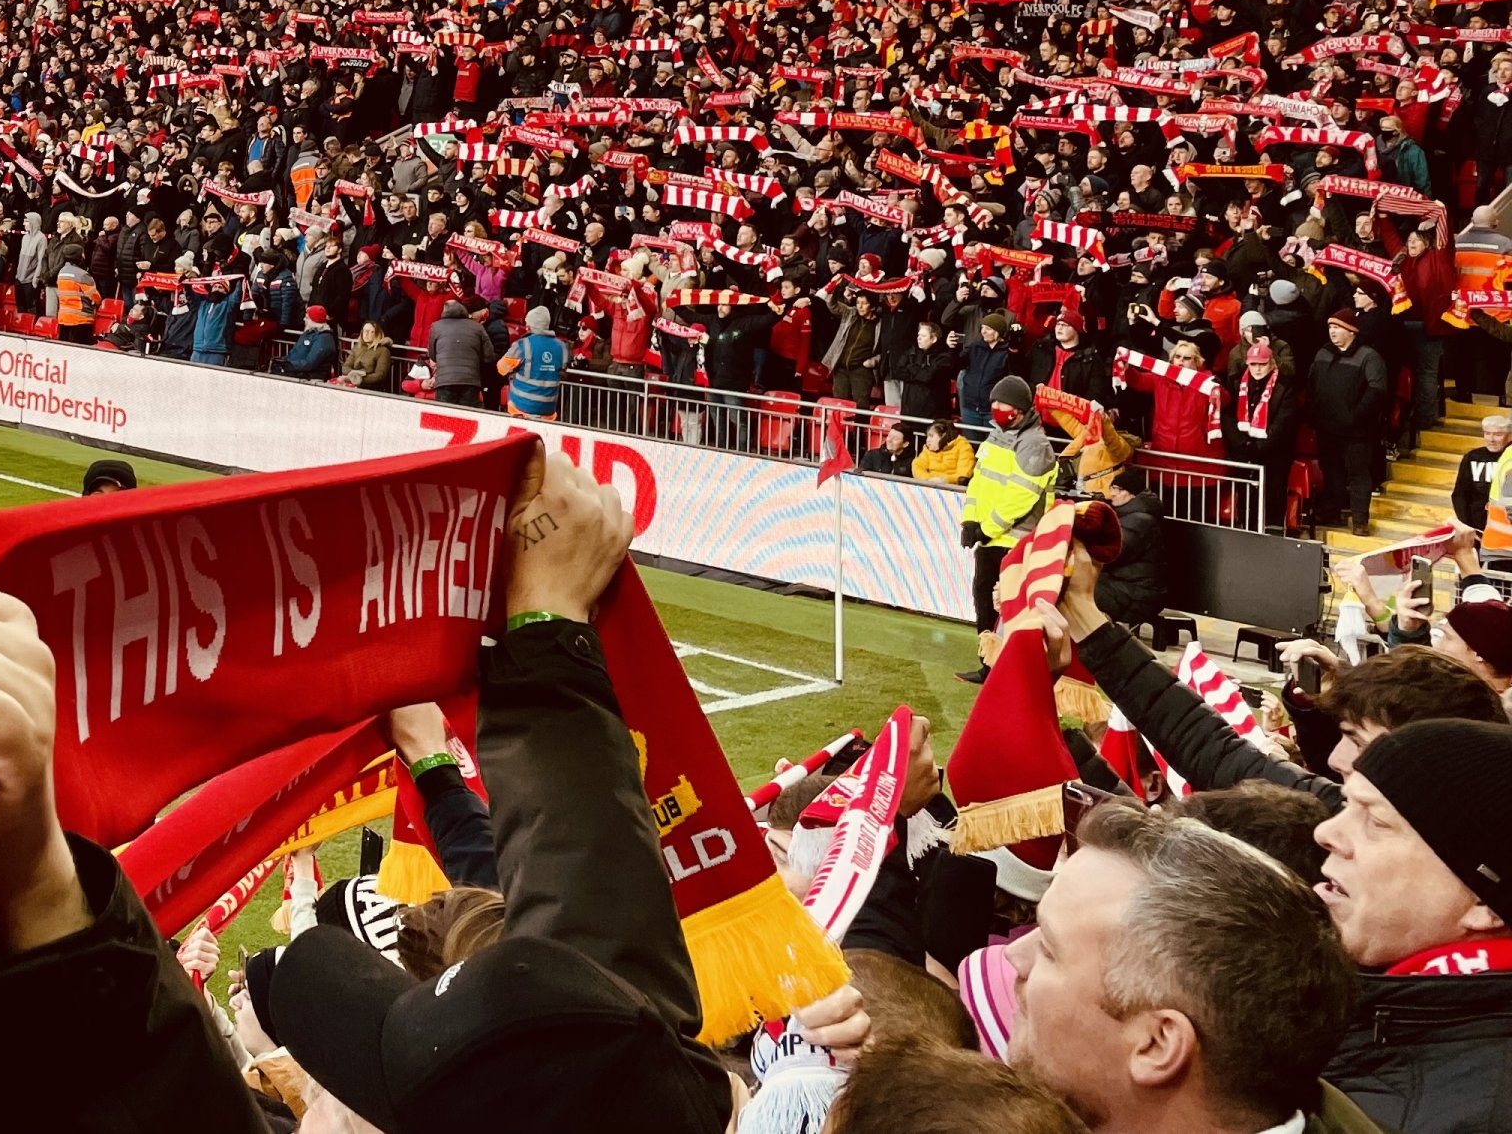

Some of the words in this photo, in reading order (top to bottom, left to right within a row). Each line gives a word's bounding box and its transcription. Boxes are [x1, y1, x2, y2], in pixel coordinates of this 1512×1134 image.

[317, 46, 360, 58] LIVERPOOL
[1311, 37, 1365, 56] LIVERPOOL
[1367, 35, 1380, 47] FC
[340, 60, 370, 69] ANFIELD
[1119, 72, 1142, 85] VAN
[668, 172, 714, 186] LIVERPOOL
[839, 190, 889, 216] LIVERPOOL
[455, 234, 498, 253] LIVERPOOL
[526, 228, 579, 251] LIVERPOOL
[1330, 248, 1346, 262] THIS
[1348, 253, 1357, 265] IS
[393, 260, 449, 278] LIVERPOOL
[143, 275, 179, 286] LIVERPO
[1467, 290, 1489, 302] THIS
[1491, 290, 1504, 302] IS
[1470, 461, 1499, 483] YN
[52, 513, 227, 743] THIS
[260, 498, 322, 657] IS
